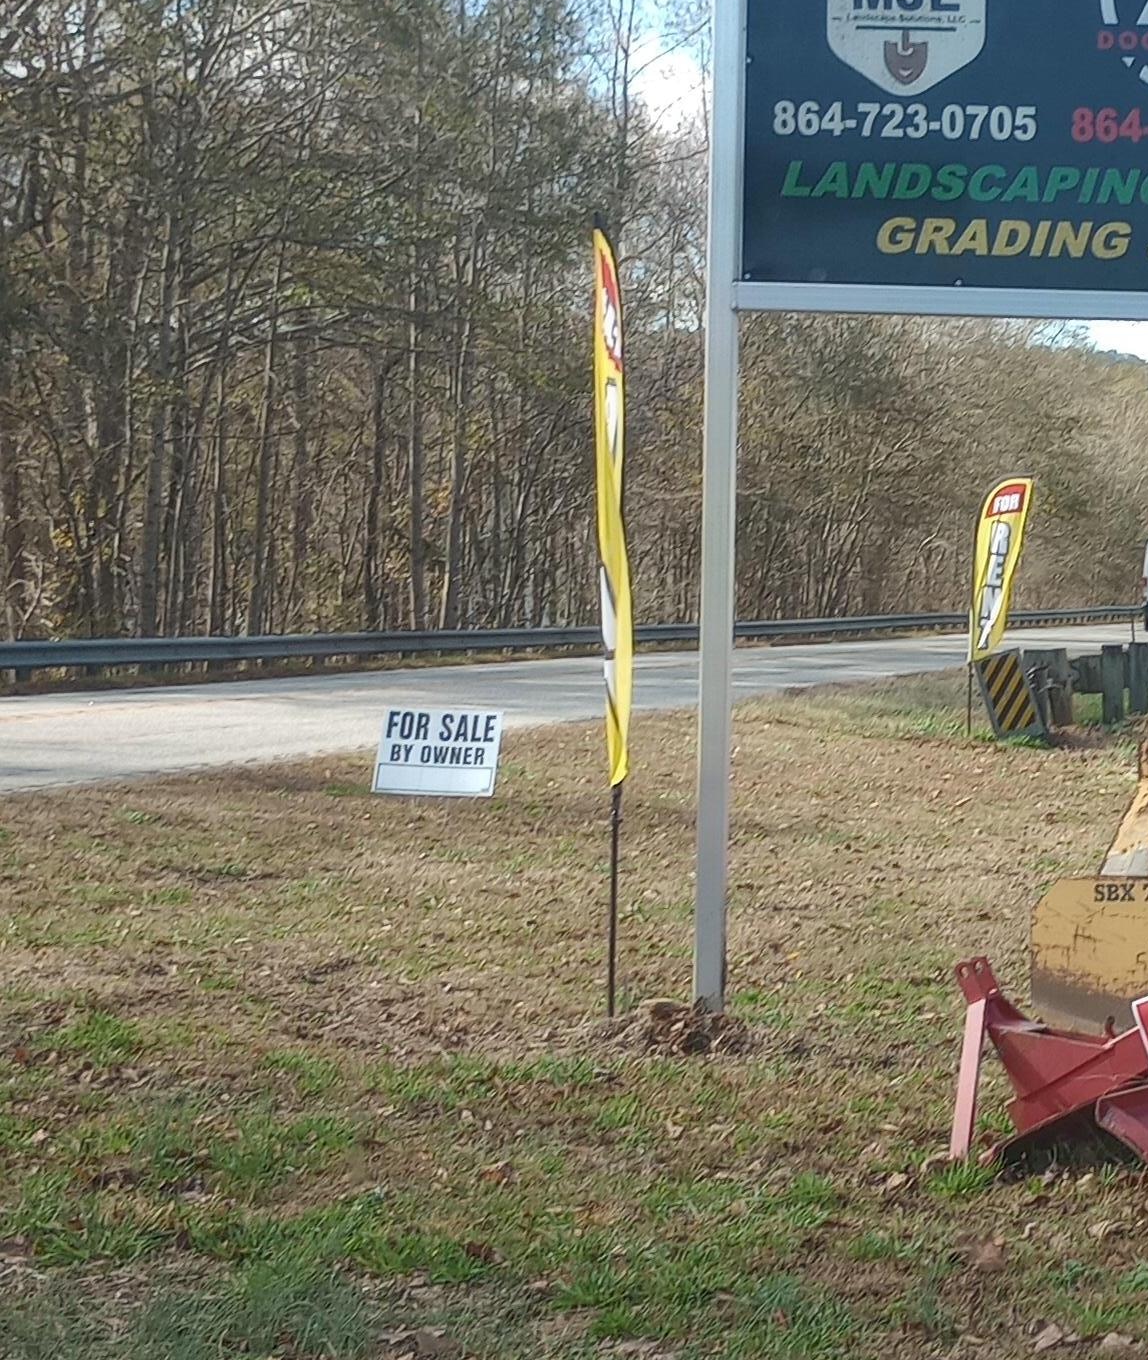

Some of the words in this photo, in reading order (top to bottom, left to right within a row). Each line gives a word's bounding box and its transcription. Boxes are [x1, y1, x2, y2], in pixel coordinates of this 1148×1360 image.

[773, 100, 1038, 140] 864-723-0705
[876, 216, 1132, 259] GRADING
[993, 493, 1020, 514] FOR
[386, 710, 430, 740] FOR
[439, 713, 497, 742] SALE
[390, 743, 415, 762] BY
[420, 745, 485, 765] OWNER
[1094, 883, 1135, 902] SBX
